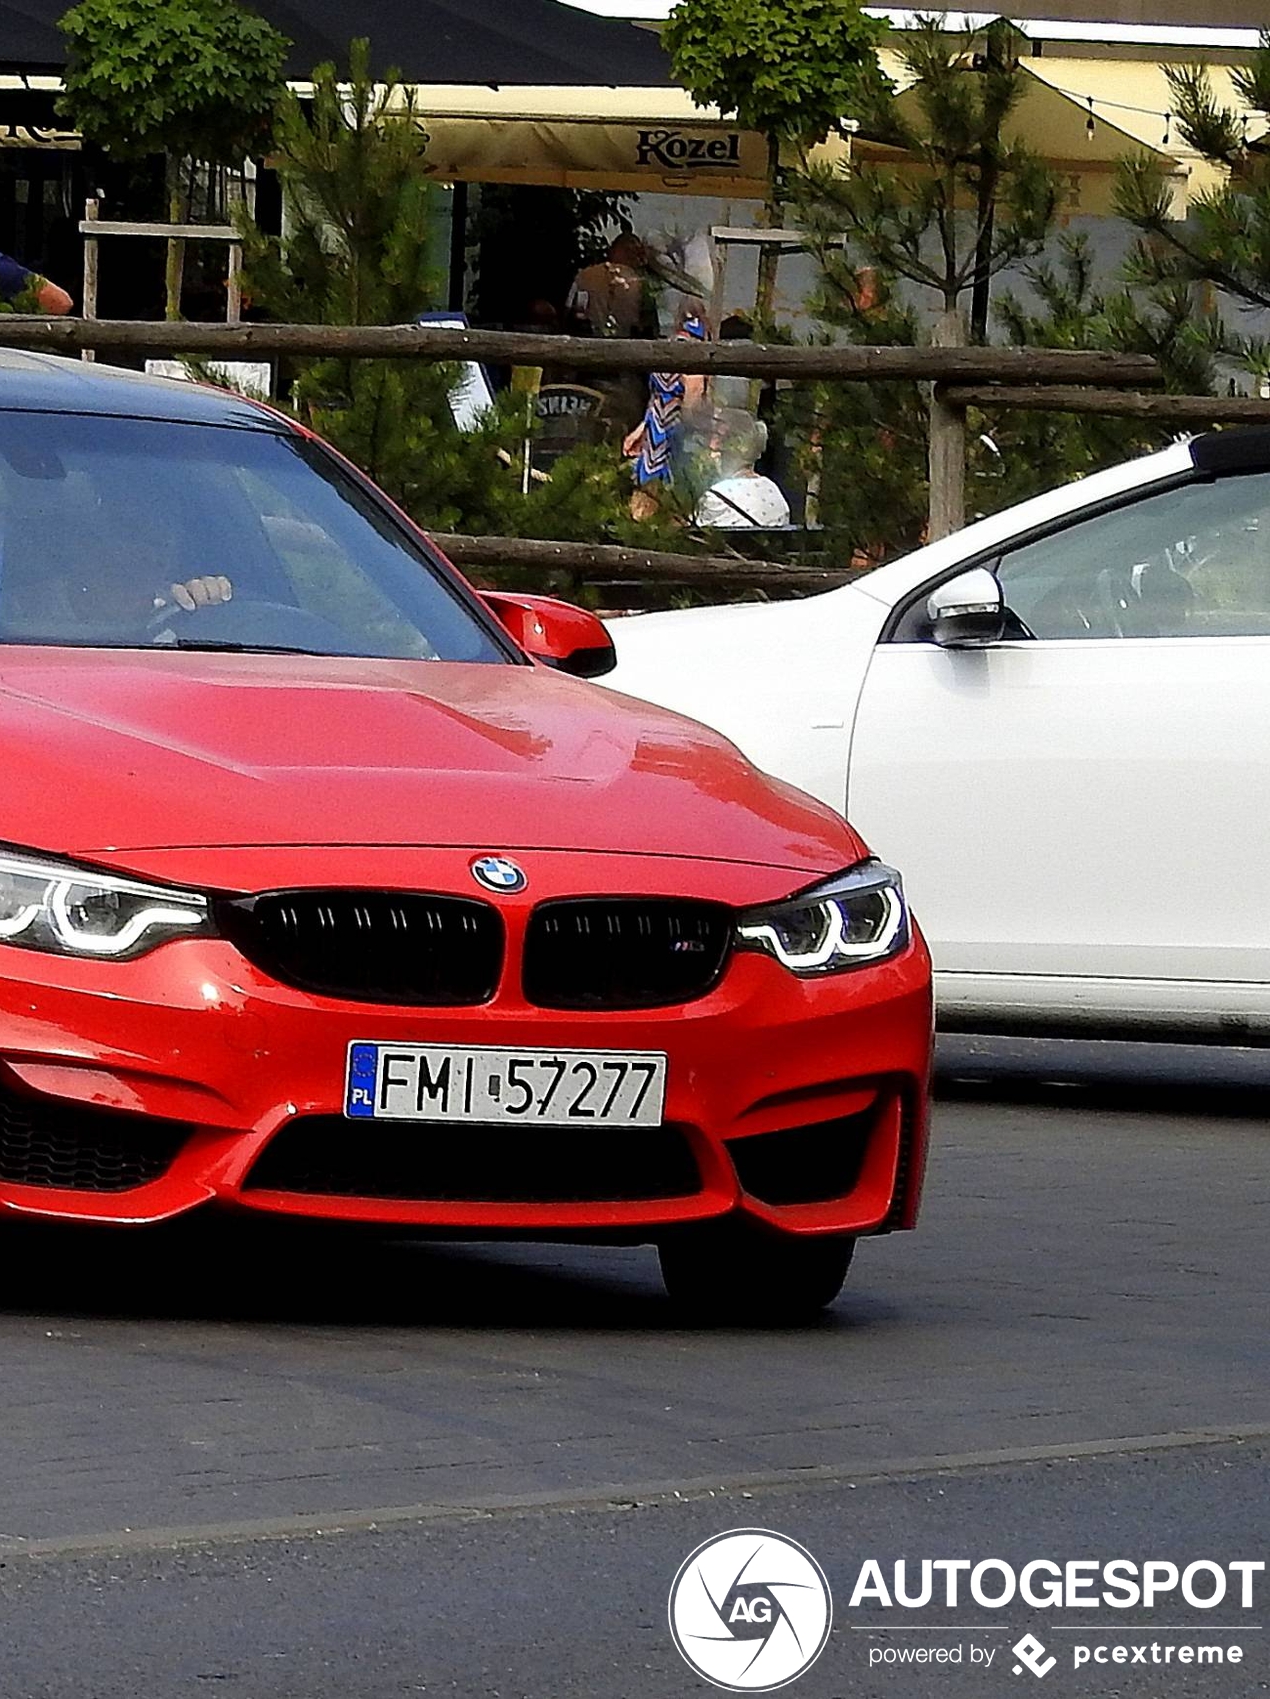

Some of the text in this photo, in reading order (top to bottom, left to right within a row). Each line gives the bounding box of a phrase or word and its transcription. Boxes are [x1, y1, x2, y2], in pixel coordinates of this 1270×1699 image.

[635, 130, 740, 168] Kozel
[351, 1088, 372, 1106] PL
[380, 1053, 658, 1119] FMI 57277
